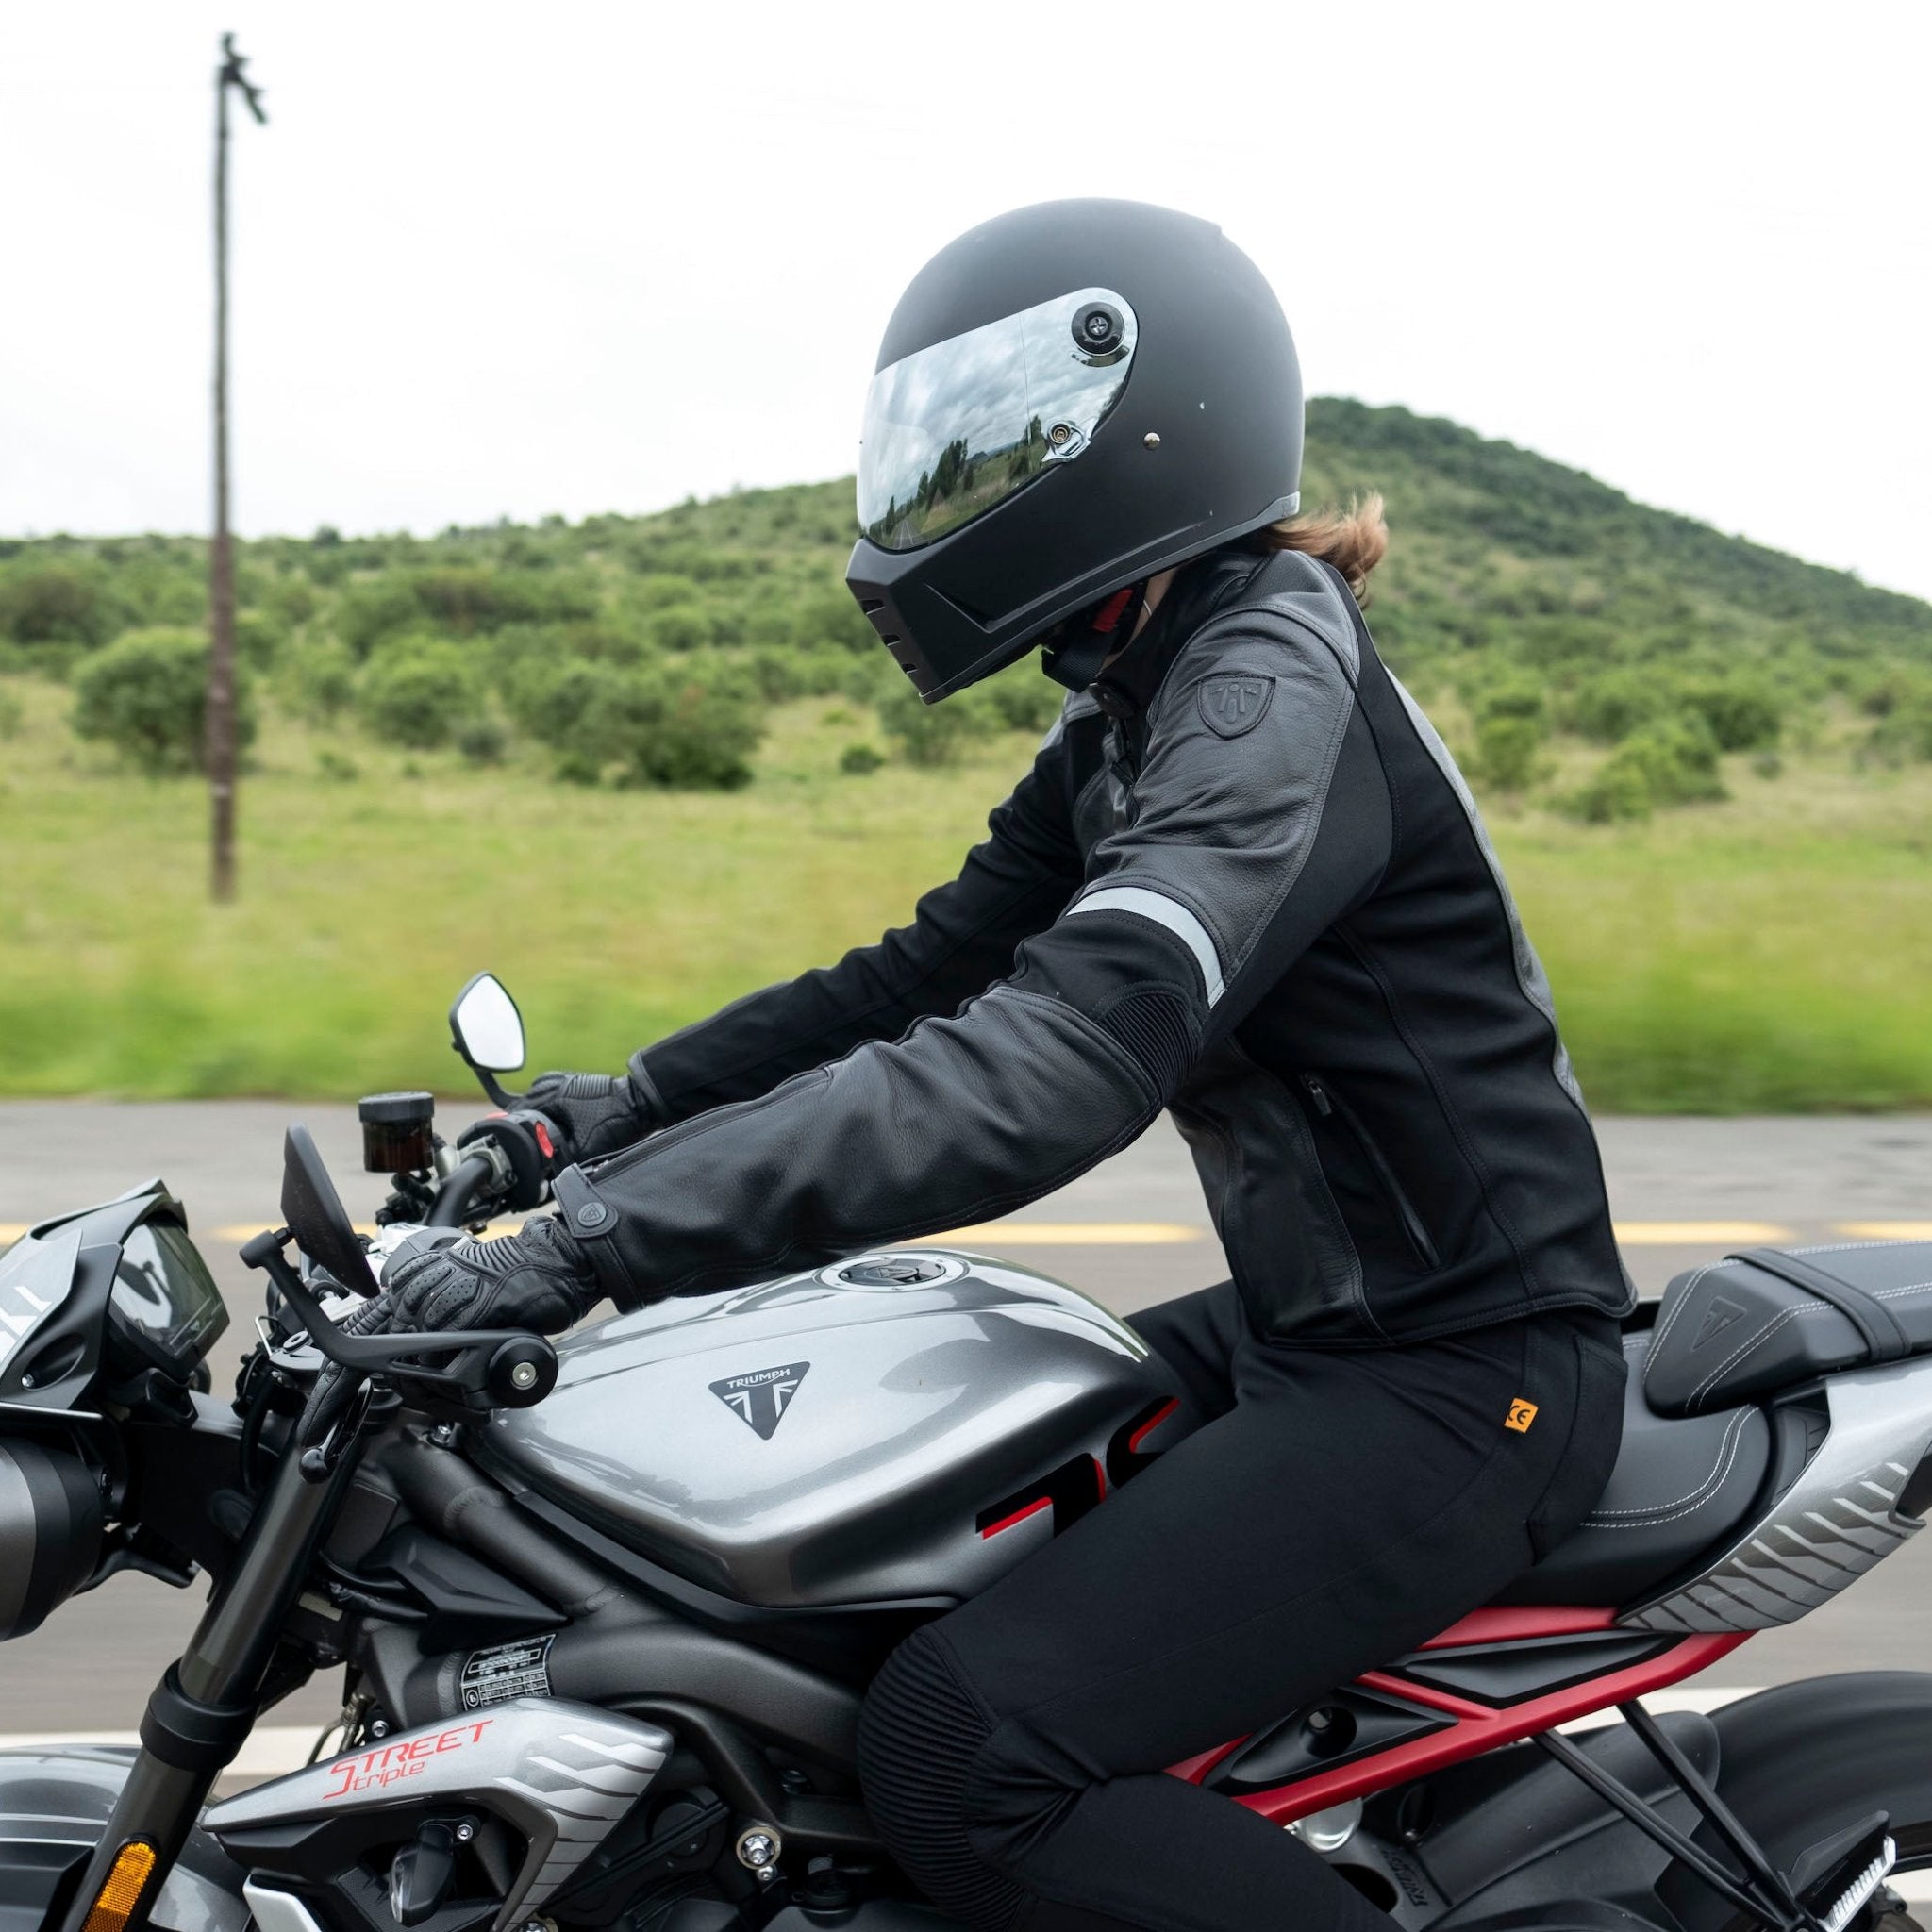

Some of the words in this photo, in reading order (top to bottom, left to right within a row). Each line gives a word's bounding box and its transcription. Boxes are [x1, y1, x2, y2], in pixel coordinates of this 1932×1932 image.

[726, 1368, 791, 1389] TRIUMPH
[1507, 1405, 1531, 1425] CE
[323, 1720, 493, 1799] STREET
[353, 1761, 425, 1790] triple
